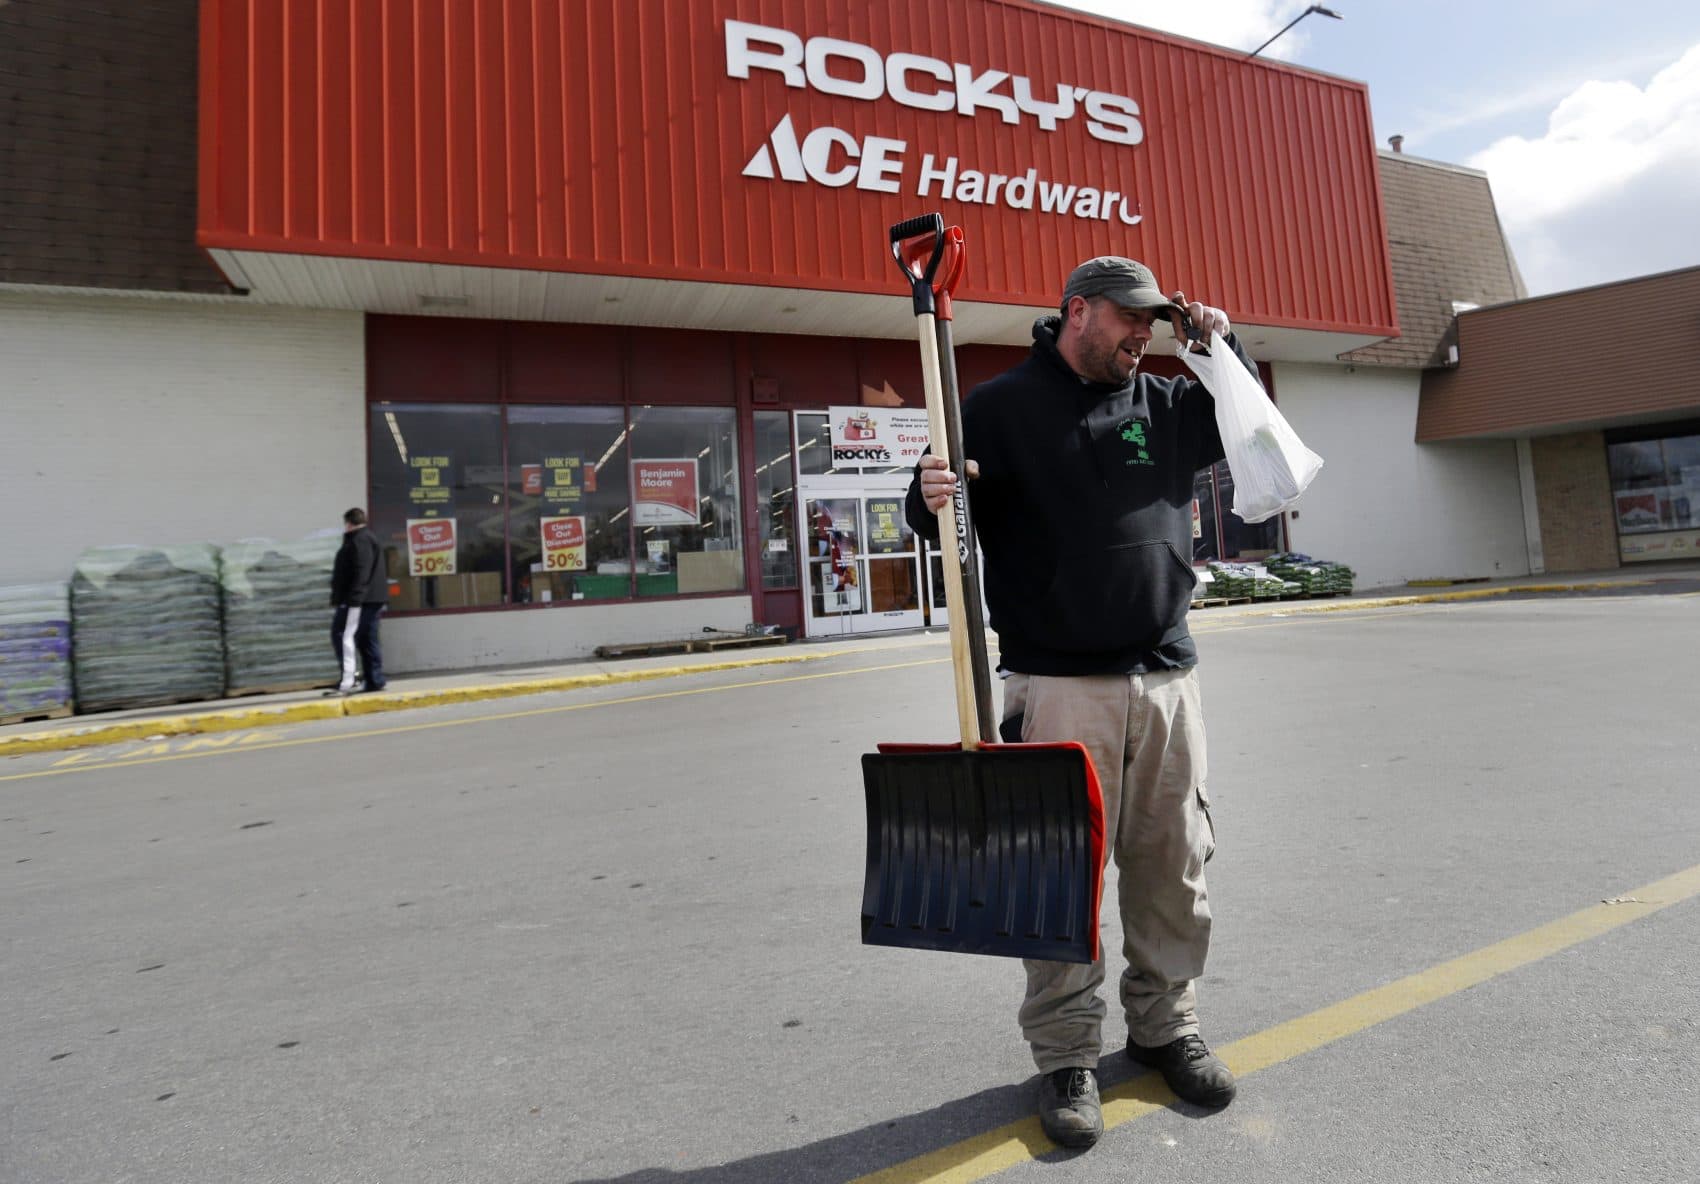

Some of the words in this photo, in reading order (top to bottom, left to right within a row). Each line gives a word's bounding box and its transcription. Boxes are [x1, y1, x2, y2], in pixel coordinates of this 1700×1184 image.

[724, 19, 1143, 145] ROCKY'S
[741, 113, 907, 193] ACE
[897, 434, 928, 443] Great
[901, 448, 919, 456] are
[545, 457, 564, 468] LOOK
[565, 457, 579, 468] FOR
[640, 468, 685, 479] Benjamin
[641, 479, 673, 487] Moore
[871, 504, 886, 512] LOOK
[887, 503, 898, 512] FOR
[414, 557, 453, 573] 50%
[547, 553, 583, 568] 50%
